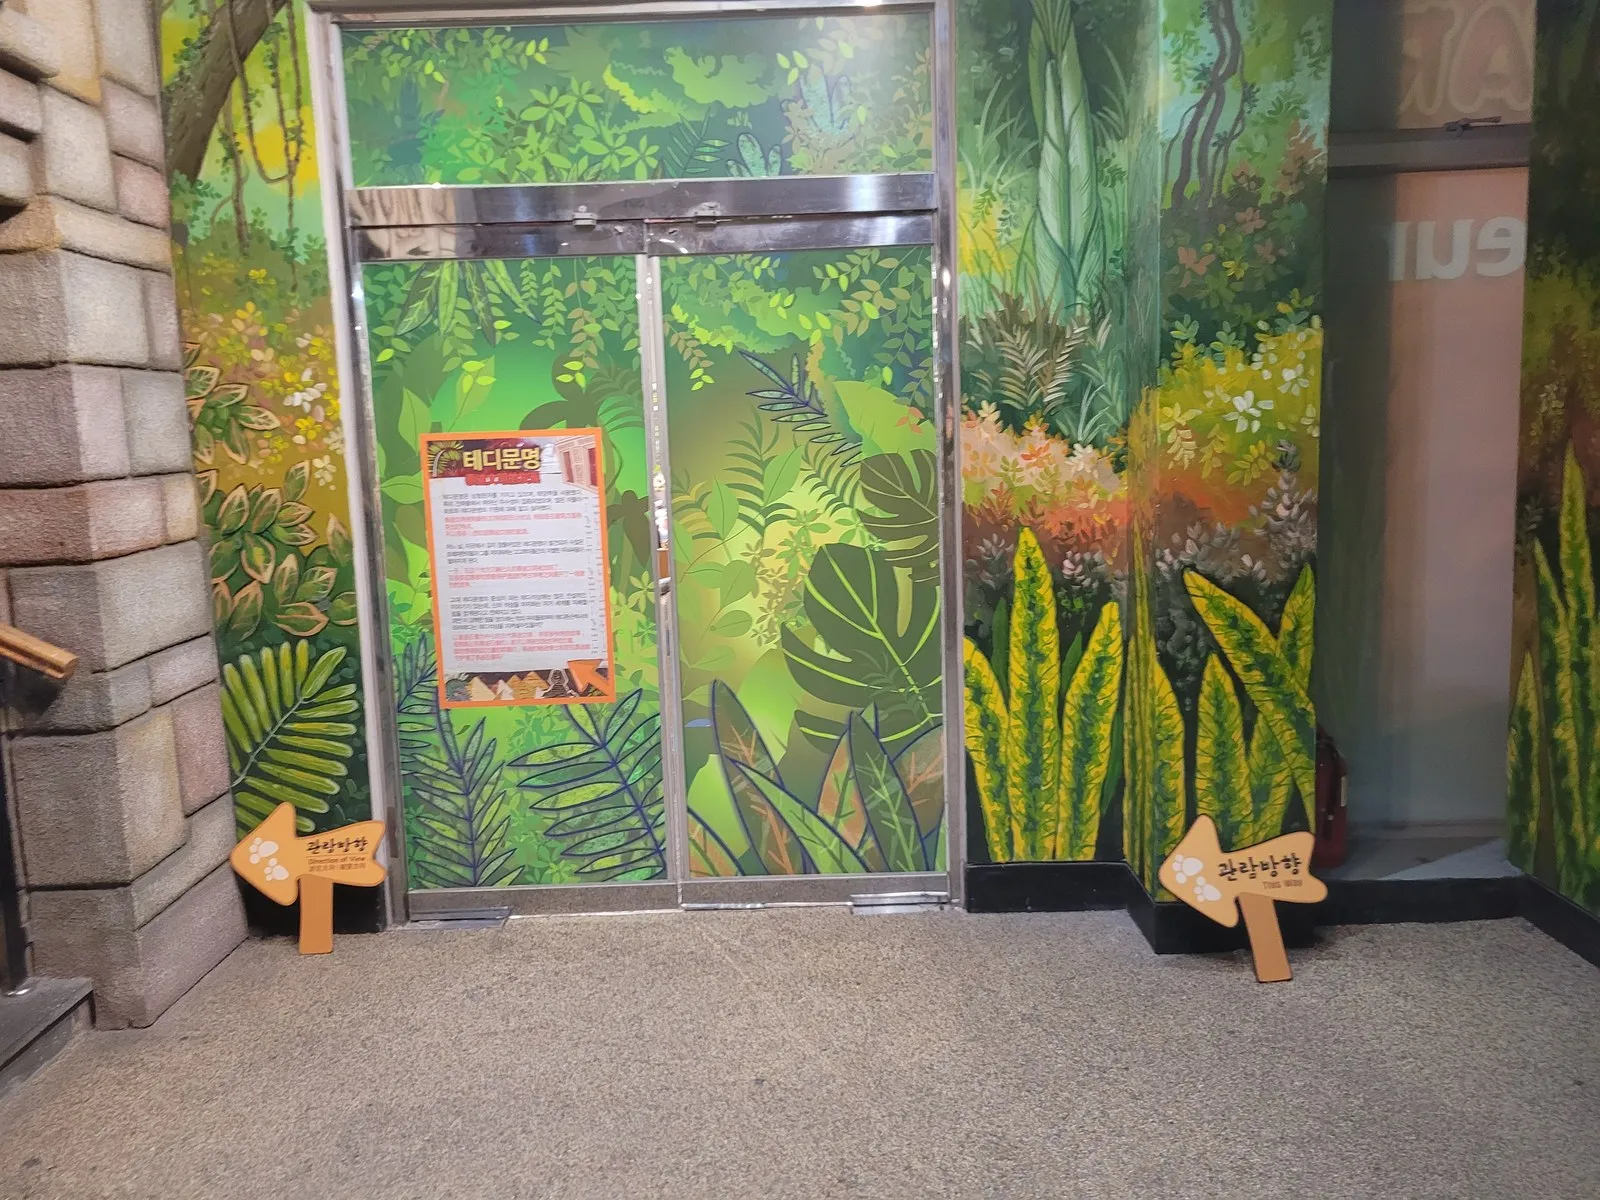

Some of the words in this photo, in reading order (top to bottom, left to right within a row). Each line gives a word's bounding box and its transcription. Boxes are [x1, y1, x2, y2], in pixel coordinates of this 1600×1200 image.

[462, 447, 541, 471] 테디문명
[307, 836, 368, 854] 관람방향
[1218, 852, 1302, 881] 관람방향
